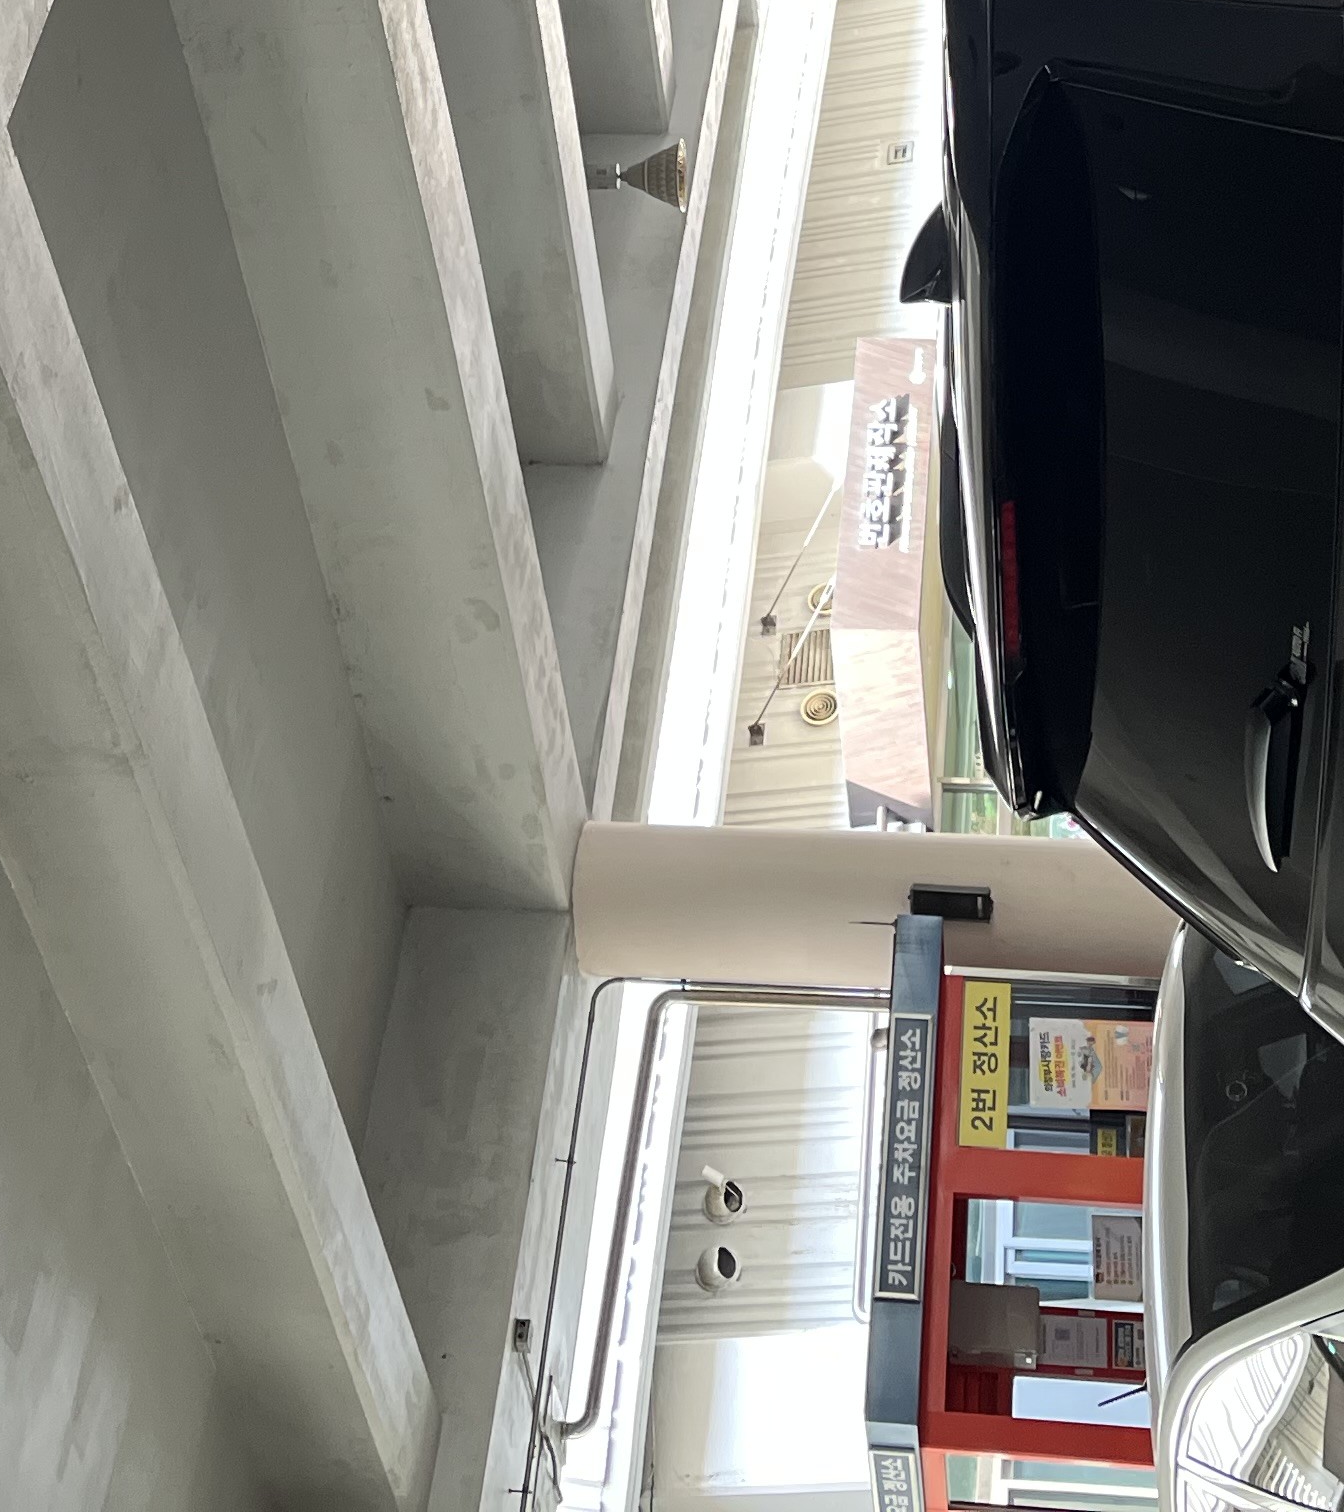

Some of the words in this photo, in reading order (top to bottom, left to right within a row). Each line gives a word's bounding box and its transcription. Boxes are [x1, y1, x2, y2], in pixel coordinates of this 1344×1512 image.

[898, 1028, 922, 1091] 정산소
[971, 996, 999, 1076] 정산소
[892, 1099, 919, 1185] 주차요금
[970, 1088, 997, 1132] 2번
[886, 1195, 916, 1286] 카드전용
[880, 1458, 908, 1492] 정산소
